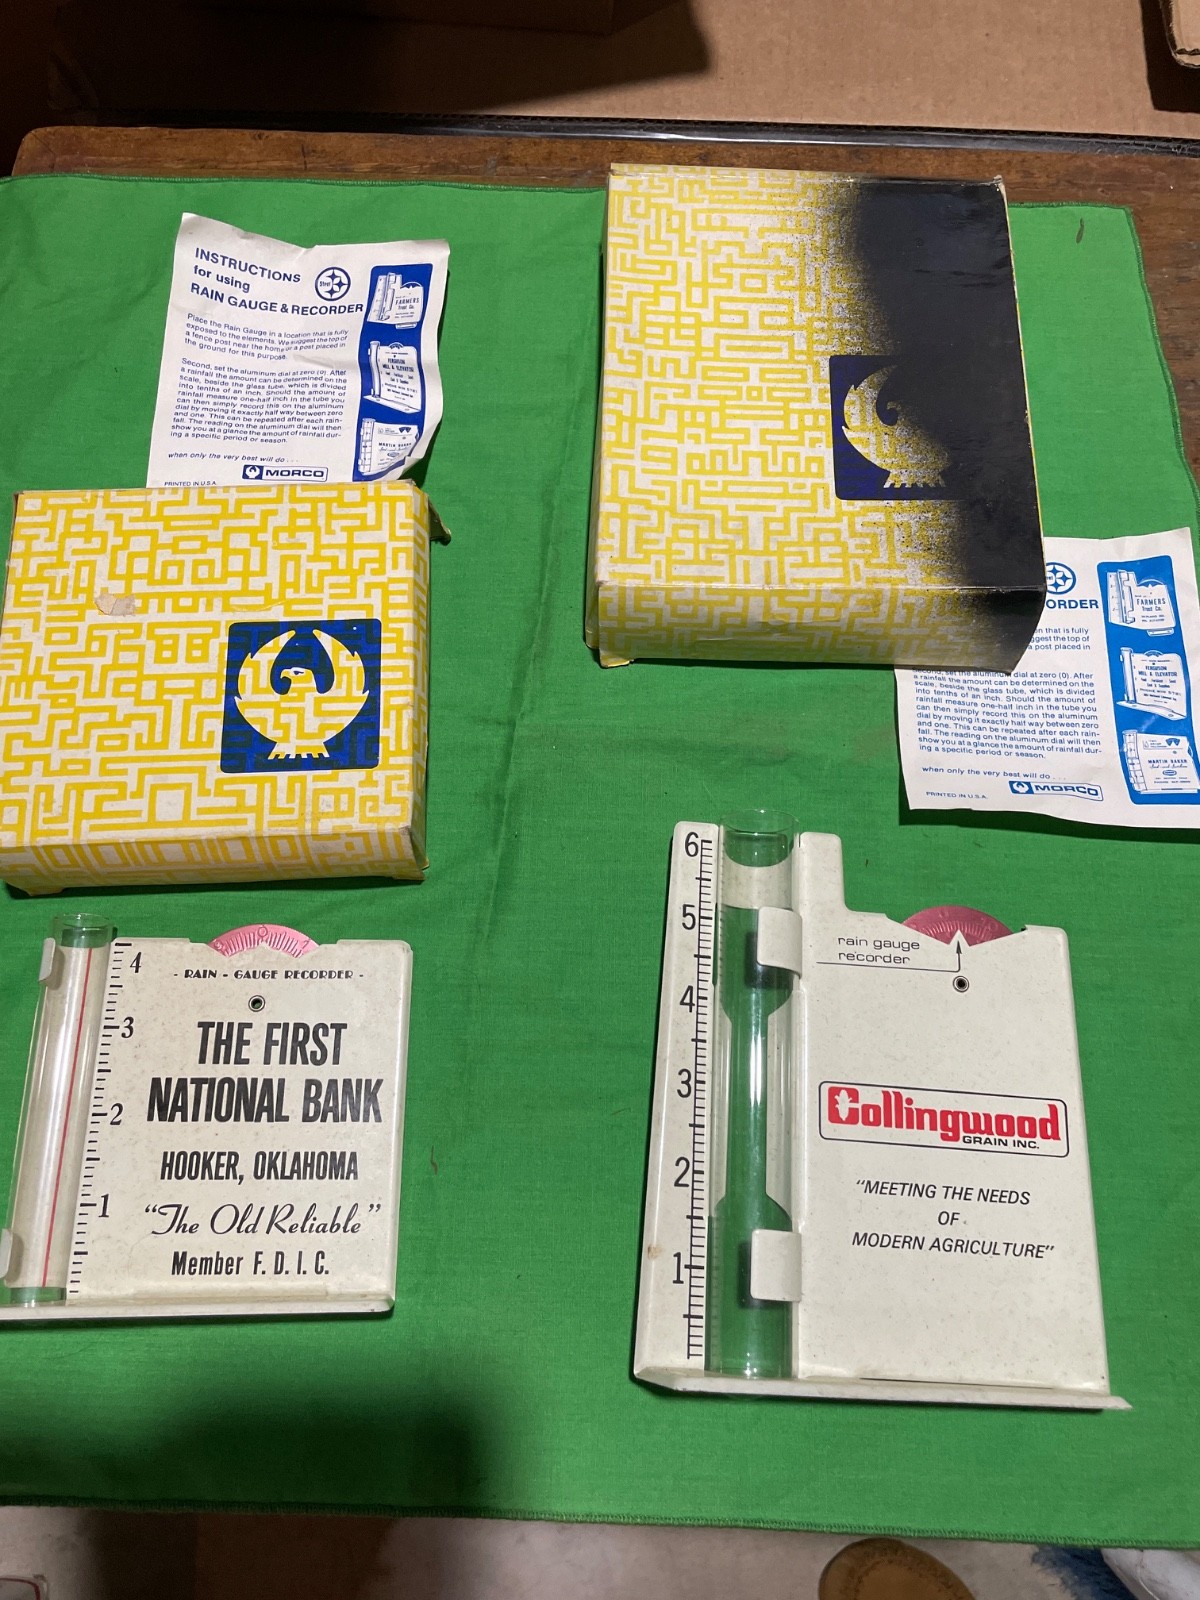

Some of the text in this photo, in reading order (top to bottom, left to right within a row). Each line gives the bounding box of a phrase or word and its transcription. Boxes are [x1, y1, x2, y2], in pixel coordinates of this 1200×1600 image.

[195, 248, 300, 282] INSTRUCTIONS
[194, 265, 250, 293] for using
[191, 283, 363, 315] RAIN GAUGE & RECORDER
[188, 314, 208, 324] Place
[209, 318, 222, 327] the
[223, 322, 240, 331] Rain
[242, 326, 267, 336] Gauge
[185, 338, 196, 346] the
[198, 343, 226, 352] ground
[189, 453, 207, 461] only
[265, 469, 324, 478] MORCO
[1046, 600, 1099, 609] ORDER
[1030, 635, 1051, 643] ggest
[1034, 643, 1052, 651] post
[1054, 643, 1081, 651] placed
[932, 713, 942, 721] by
[943, 715, 973, 724] moving
[981, 719, 1009, 727] exactly
[953, 707, 979, 716] simply
[946, 768, 964, 776] only
[1035, 785, 1098, 796] MORCO
[684, 832, 699, 857] 6
[682, 904, 696, 930] 5
[838, 936, 920, 951] rain gauge
[130, 952, 142, 973] 4
[838, 951, 910, 964] recorder
[184, 970, 217, 978] RAIN
[234, 970, 278, 979] GAUGE
[284, 970, 354, 979] RECORDER
[680, 985, 695, 1013] 4
[121, 1016, 134, 1038] 3
[197, 1022, 347, 1066] THE FIRST
[677, 1068, 691, 1098] 3
[147, 1077, 383, 1122] NATIONAL BANK
[110, 1103, 123, 1126] 2
[828, 1086, 1061, 1142] Collingwood
[962, 1135, 1040, 1149] GRAIN INC.
[160, 1151, 358, 1185] HOOKER, OKLAHOMA
[674, 1157, 690, 1187] 2
[856, 1180, 1030, 1205] “MEETING THE NEEDS
[99, 1194, 110, 1218] 1
[144, 1203, 381, 1235] “The Old Reliable”
[938, 1211, 960, 1225] OF
[852, 1232, 1054, 1258] MODERN AGRICULTURE”
[172, 1251, 243, 1275] Member
[672, 1252, 684, 1284] 1
